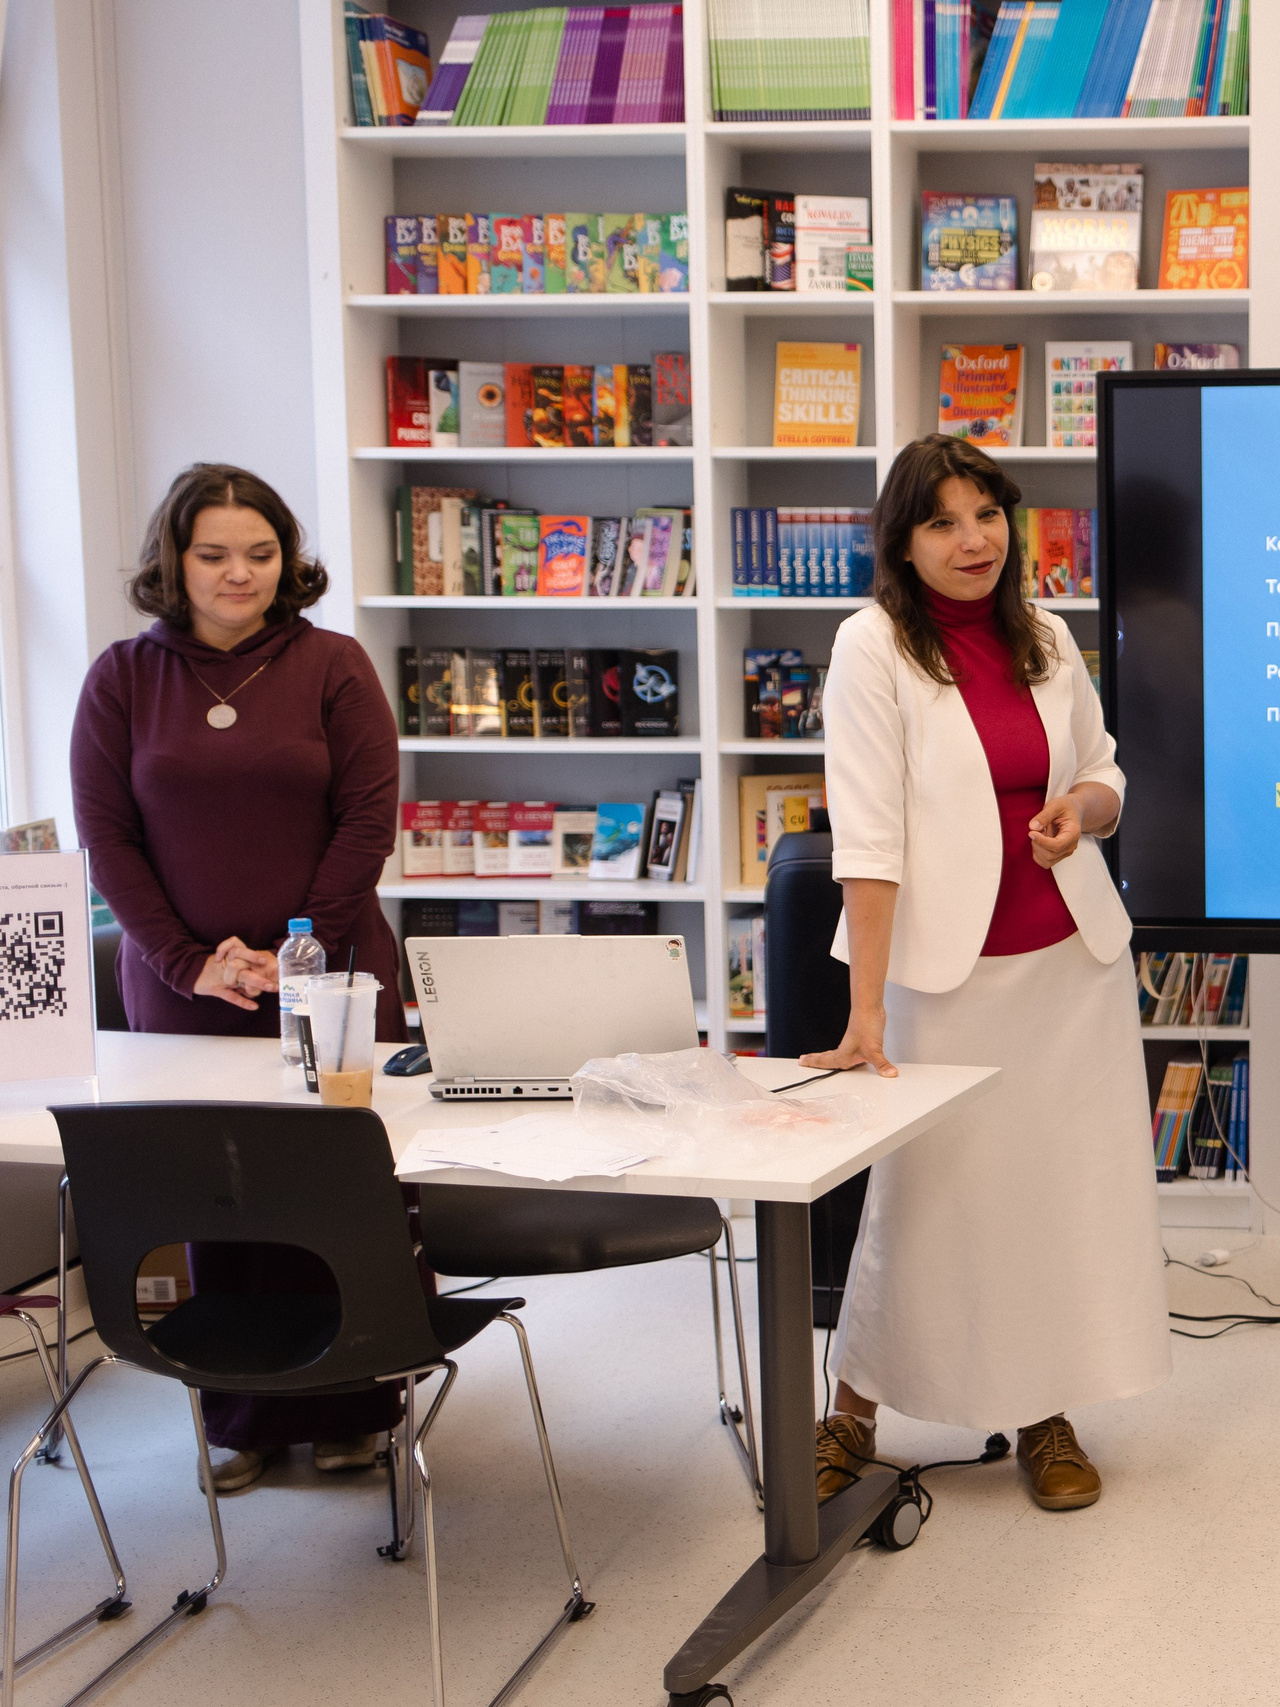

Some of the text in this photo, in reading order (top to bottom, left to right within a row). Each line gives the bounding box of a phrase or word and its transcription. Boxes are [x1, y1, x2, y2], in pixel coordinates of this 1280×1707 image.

[1044, 217, 1128, 233] WORLD
[941, 236, 999, 251] PHYSICS
[1040, 232, 1131, 248] HISTORY
[955, 354, 1010, 371] Oxford
[1052, 356, 1126, 371] ON THIS DAY
[1168, 351, 1225, 369] Oxford
[779, 367, 857, 386] CRITICAL
[957, 371, 1006, 383] Primary
[779, 386, 857, 403] THINKING
[953, 381, 1008, 393] Illustrated
[777, 402, 856, 424] SKILLS
[953, 406, 1005, 417] Dictionary
[778, 548, 791, 585] English
[793, 548, 806, 585] English
[807, 548, 820, 585] English
[822, 548, 835, 585] English
[837, 548, 850, 585] English
[416, 951, 439, 1003] LEGION
